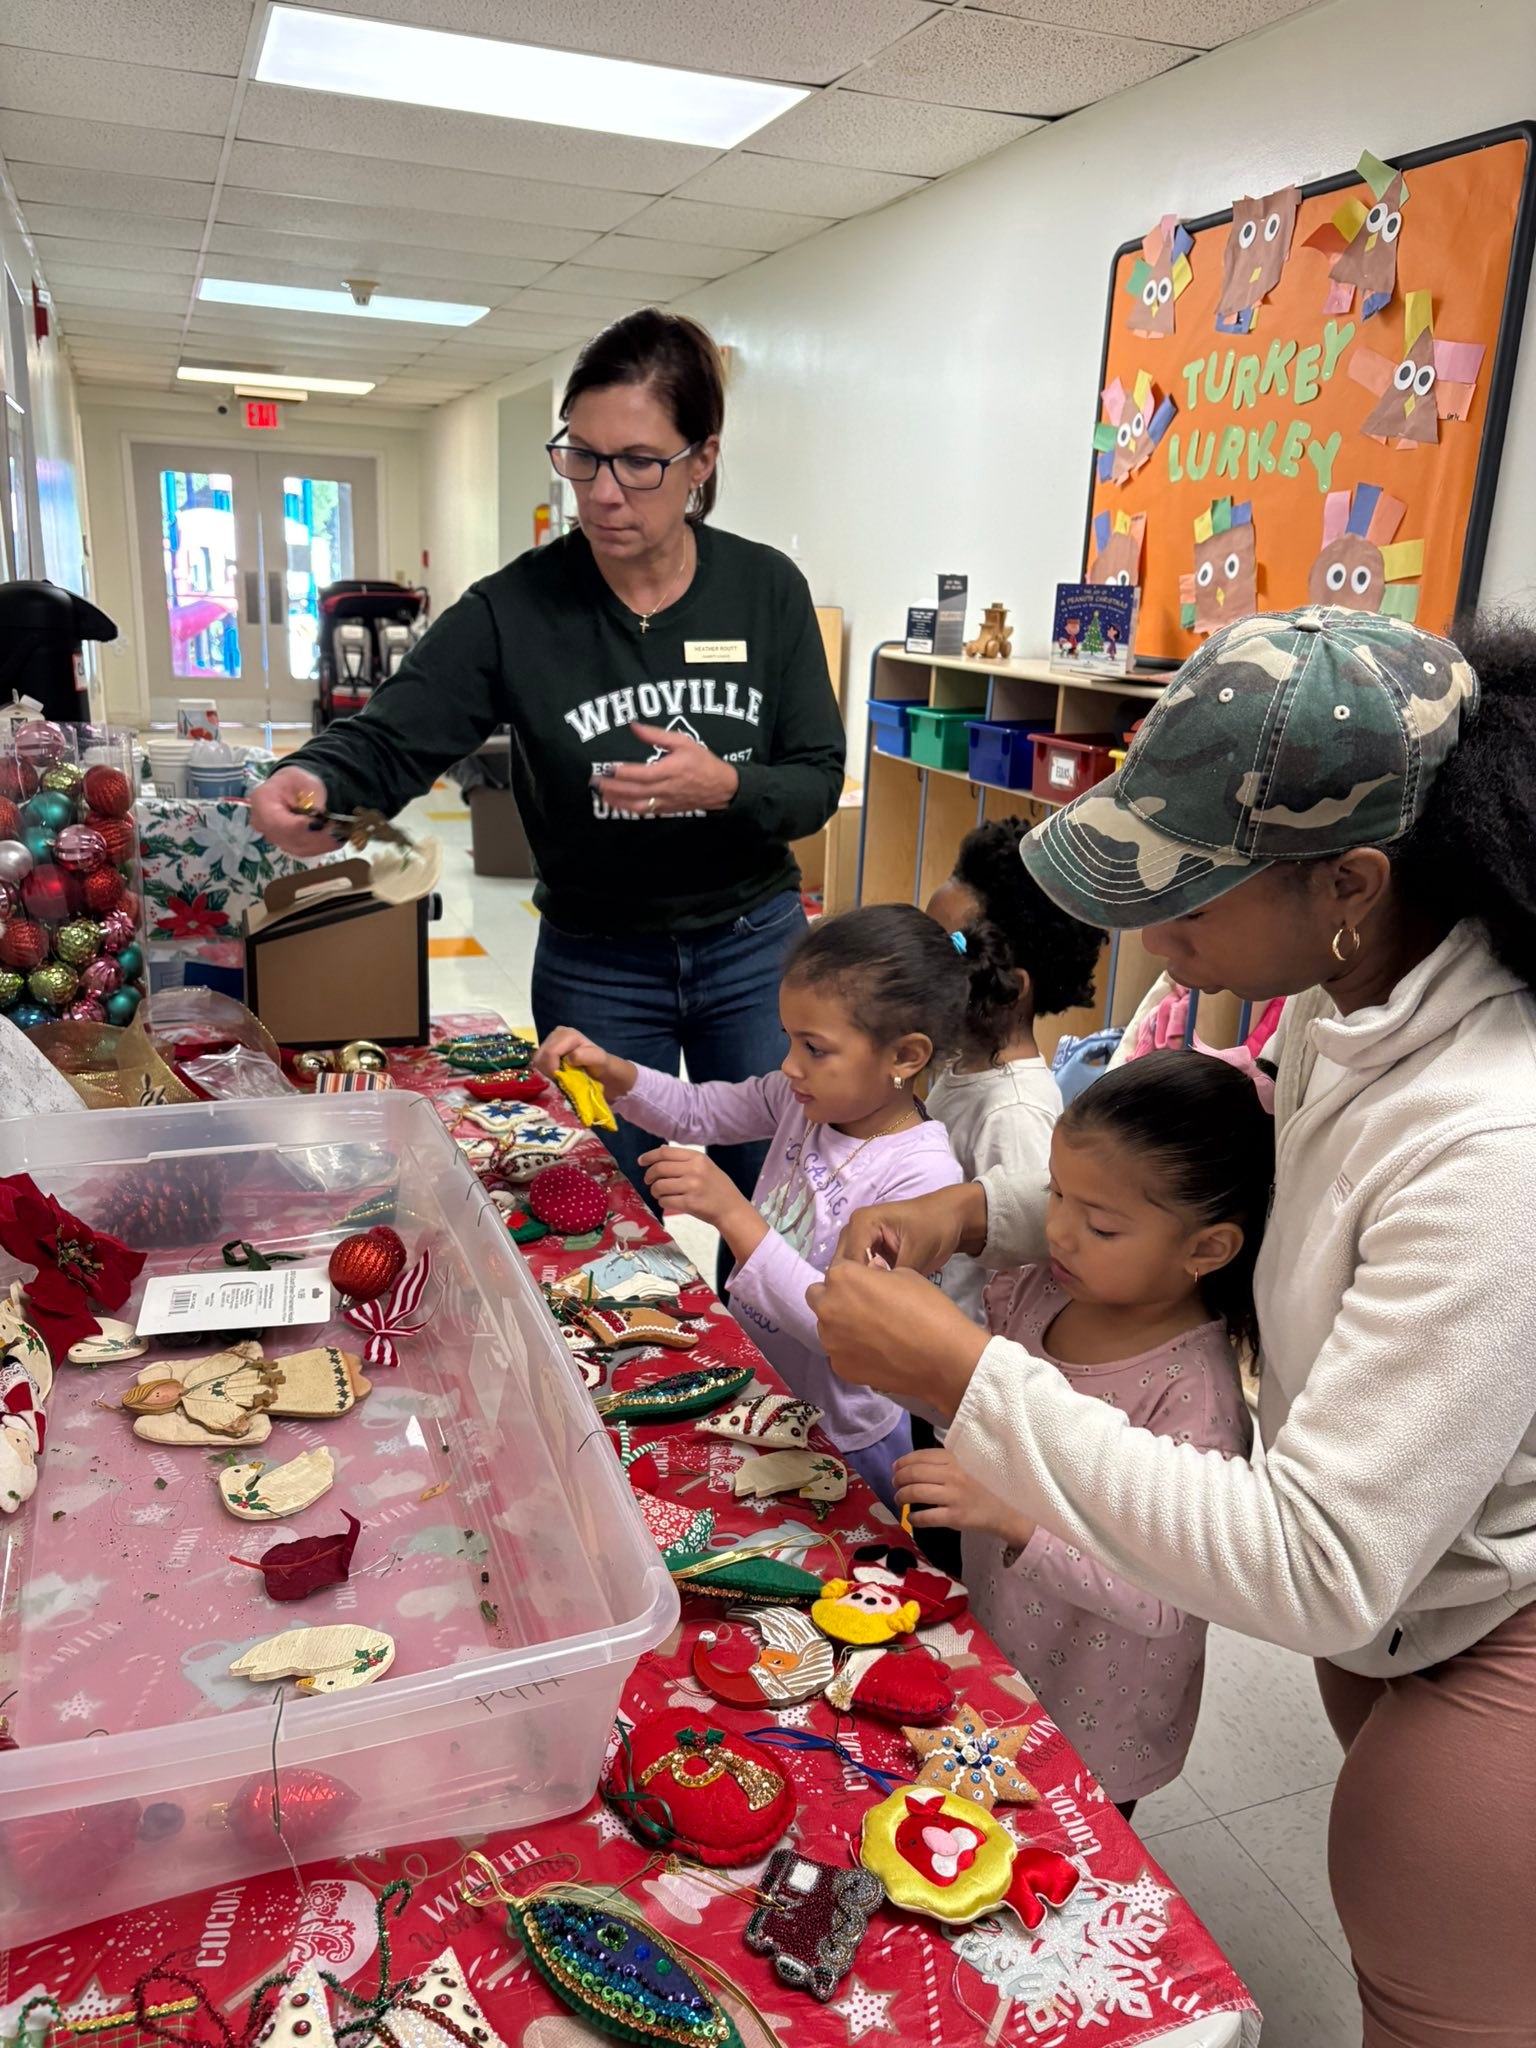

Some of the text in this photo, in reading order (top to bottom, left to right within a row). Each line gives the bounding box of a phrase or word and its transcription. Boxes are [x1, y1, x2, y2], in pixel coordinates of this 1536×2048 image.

[1182, 319, 1356, 410] TURKEY
[246, 402, 278, 428] EXIT
[1168, 420, 1342, 494] LURKEY
[564, 679, 763, 743] WHOVILLE
[803, 1152, 848, 1216] CASTLE
[1043, 1783, 1102, 1857] COCOA
[195, 1886, 246, 1967] COCOA
